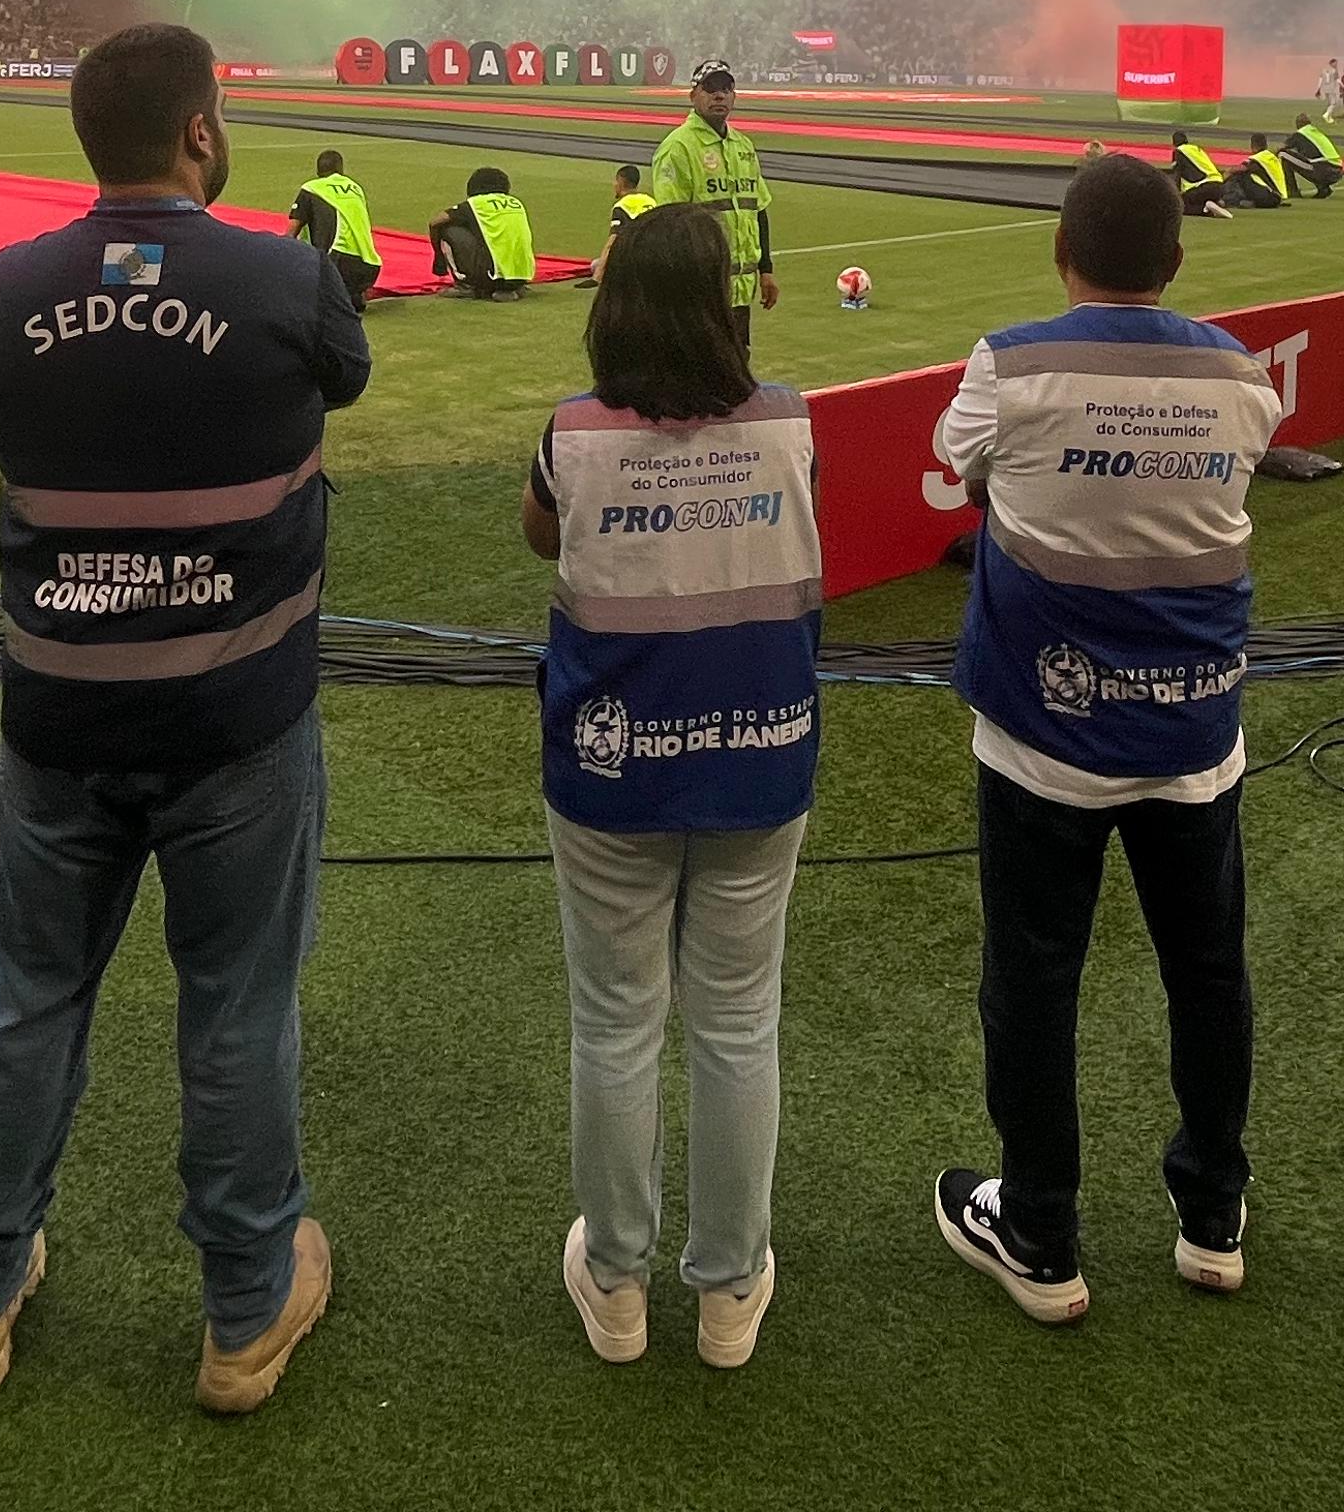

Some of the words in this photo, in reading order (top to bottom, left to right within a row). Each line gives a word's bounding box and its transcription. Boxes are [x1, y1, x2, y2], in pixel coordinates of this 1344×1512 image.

[8, 63, 55, 78] FERJ
[834, 73, 858, 84] FERJ
[912, 74, 938, 85] FERJ
[1124, 71, 1176, 85] SUPERBET
[327, 183, 361, 196] TKS
[487, 198, 522, 211] TKS
[24, 294, 229, 356] SEDCON
[1086, 402, 1154, 420] Proteção
[1159, 407, 1168, 418] e
[1173, 405, 1218, 420] Defesa
[1096, 423, 1115, 436] do
[1121, 423, 1211, 438] Consumidor
[619, 455, 690, 472] Proteção
[696, 456, 704, 467] e
[709, 450, 760, 466] Defesa
[631, 476, 652, 491] do
[657, 471, 752, 489] Consumidor
[57, 553, 164, 585] DEFESA
[173, 554, 214, 582] DO
[35, 573, 234, 614] CONSUMIDOR
[1195, 663, 1216, 676] DO
[1101, 678, 1149, 701] RIO
[1153, 681, 1186, 705] DE
[633, 710, 723, 733] GOVERNO
[733, 709, 757, 723] DO
[767, 696, 814, 721] ESTADO
[633, 735, 682, 758] RIO
[687, 727, 723, 752] DE
[727, 711, 812, 750] JANEIRO
